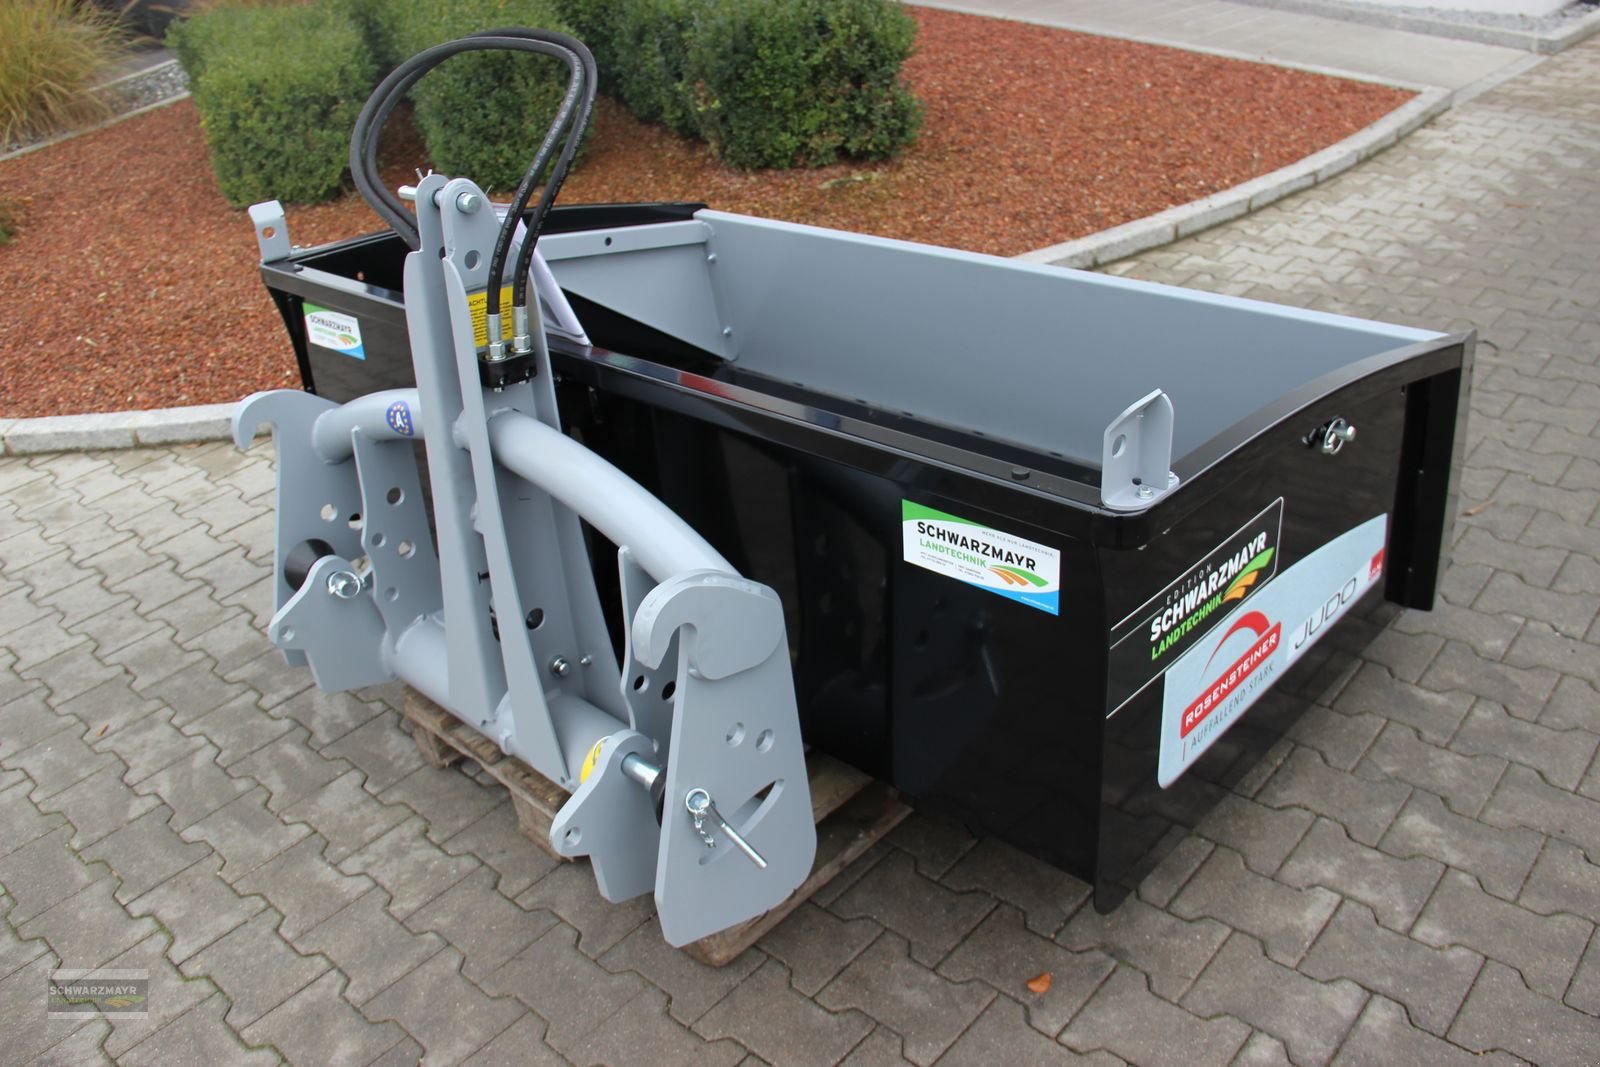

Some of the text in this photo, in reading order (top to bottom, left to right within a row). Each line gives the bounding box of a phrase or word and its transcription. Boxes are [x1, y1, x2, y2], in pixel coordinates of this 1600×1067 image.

[917, 521, 1036, 571] SCHWARZMAYR
[919, 538, 987, 568] LANDTECHNIK
[1150, 531, 1267, 642] SCHWARZMAYR
[1166, 563, 1212, 605] EDITION
[1295, 577, 1357, 649] JUDO
[1151, 591, 1223, 660] LANDTECHNIK
[1185, 632, 1277, 727] ROSENSTEINER
[1191, 662, 1274, 750] AUFFALLEND STARK
